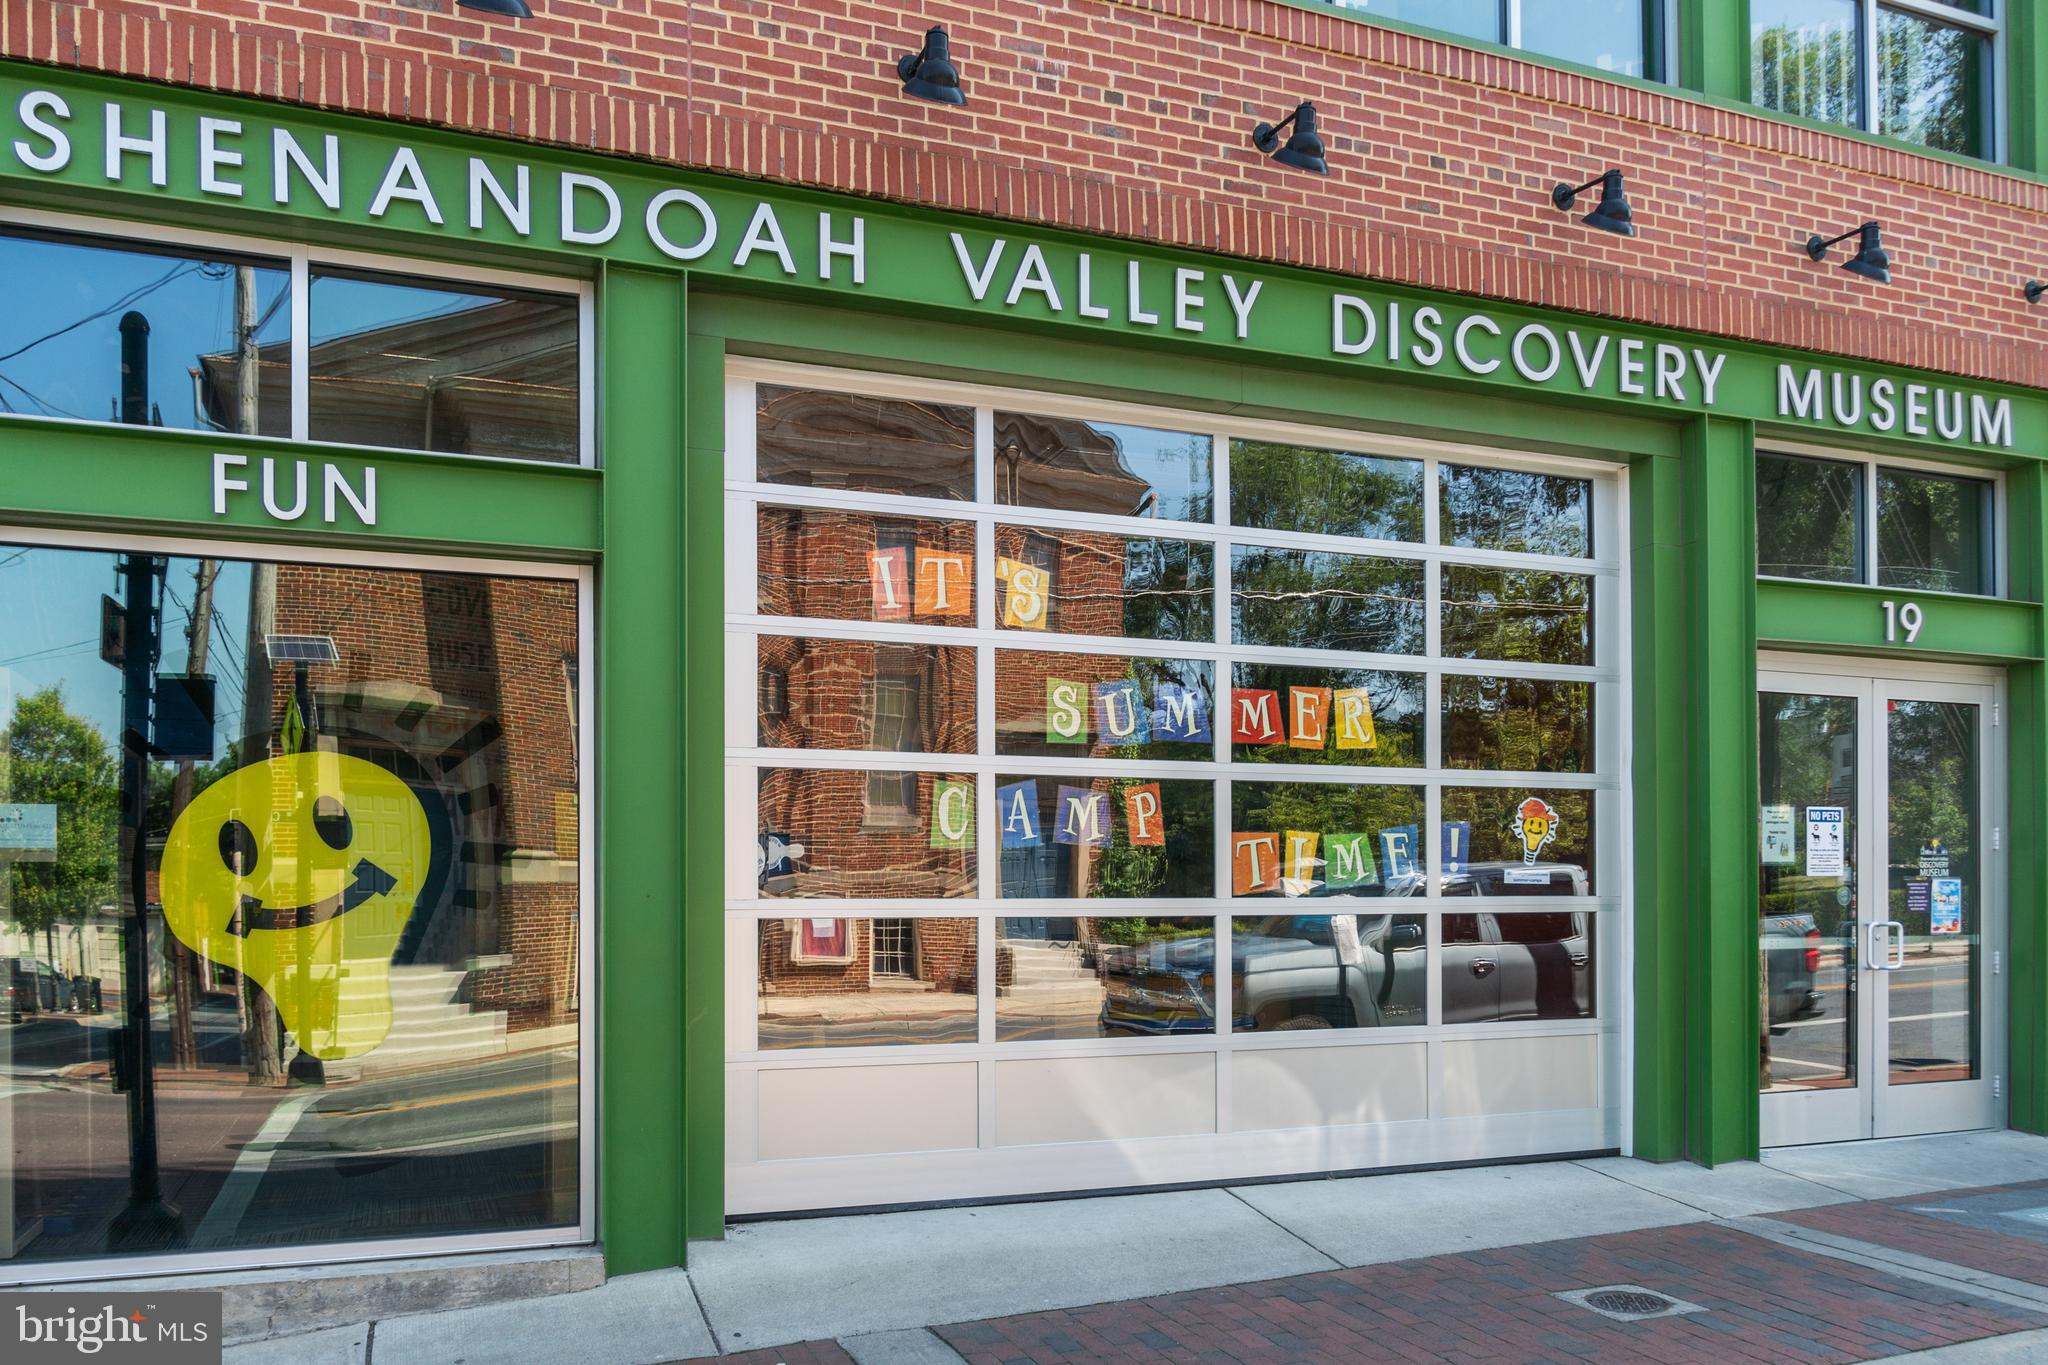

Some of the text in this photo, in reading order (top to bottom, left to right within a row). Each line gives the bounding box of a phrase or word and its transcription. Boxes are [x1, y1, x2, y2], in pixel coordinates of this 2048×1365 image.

[13, 90, 2017, 450] SHENANDOAH VALLEY DISCOVERY MUSEUM
[212, 452, 378, 526] FUN
[872, 556, 1042, 622] IT'S
[1881, 600, 1925, 645] 19
[1052, 684, 1371, 744] SUMMER
[938, 785, 1157, 842] CAMP
[1810, 811, 1840, 821] NO PETS
[1919, 869, 1949, 877] MUSEUM
